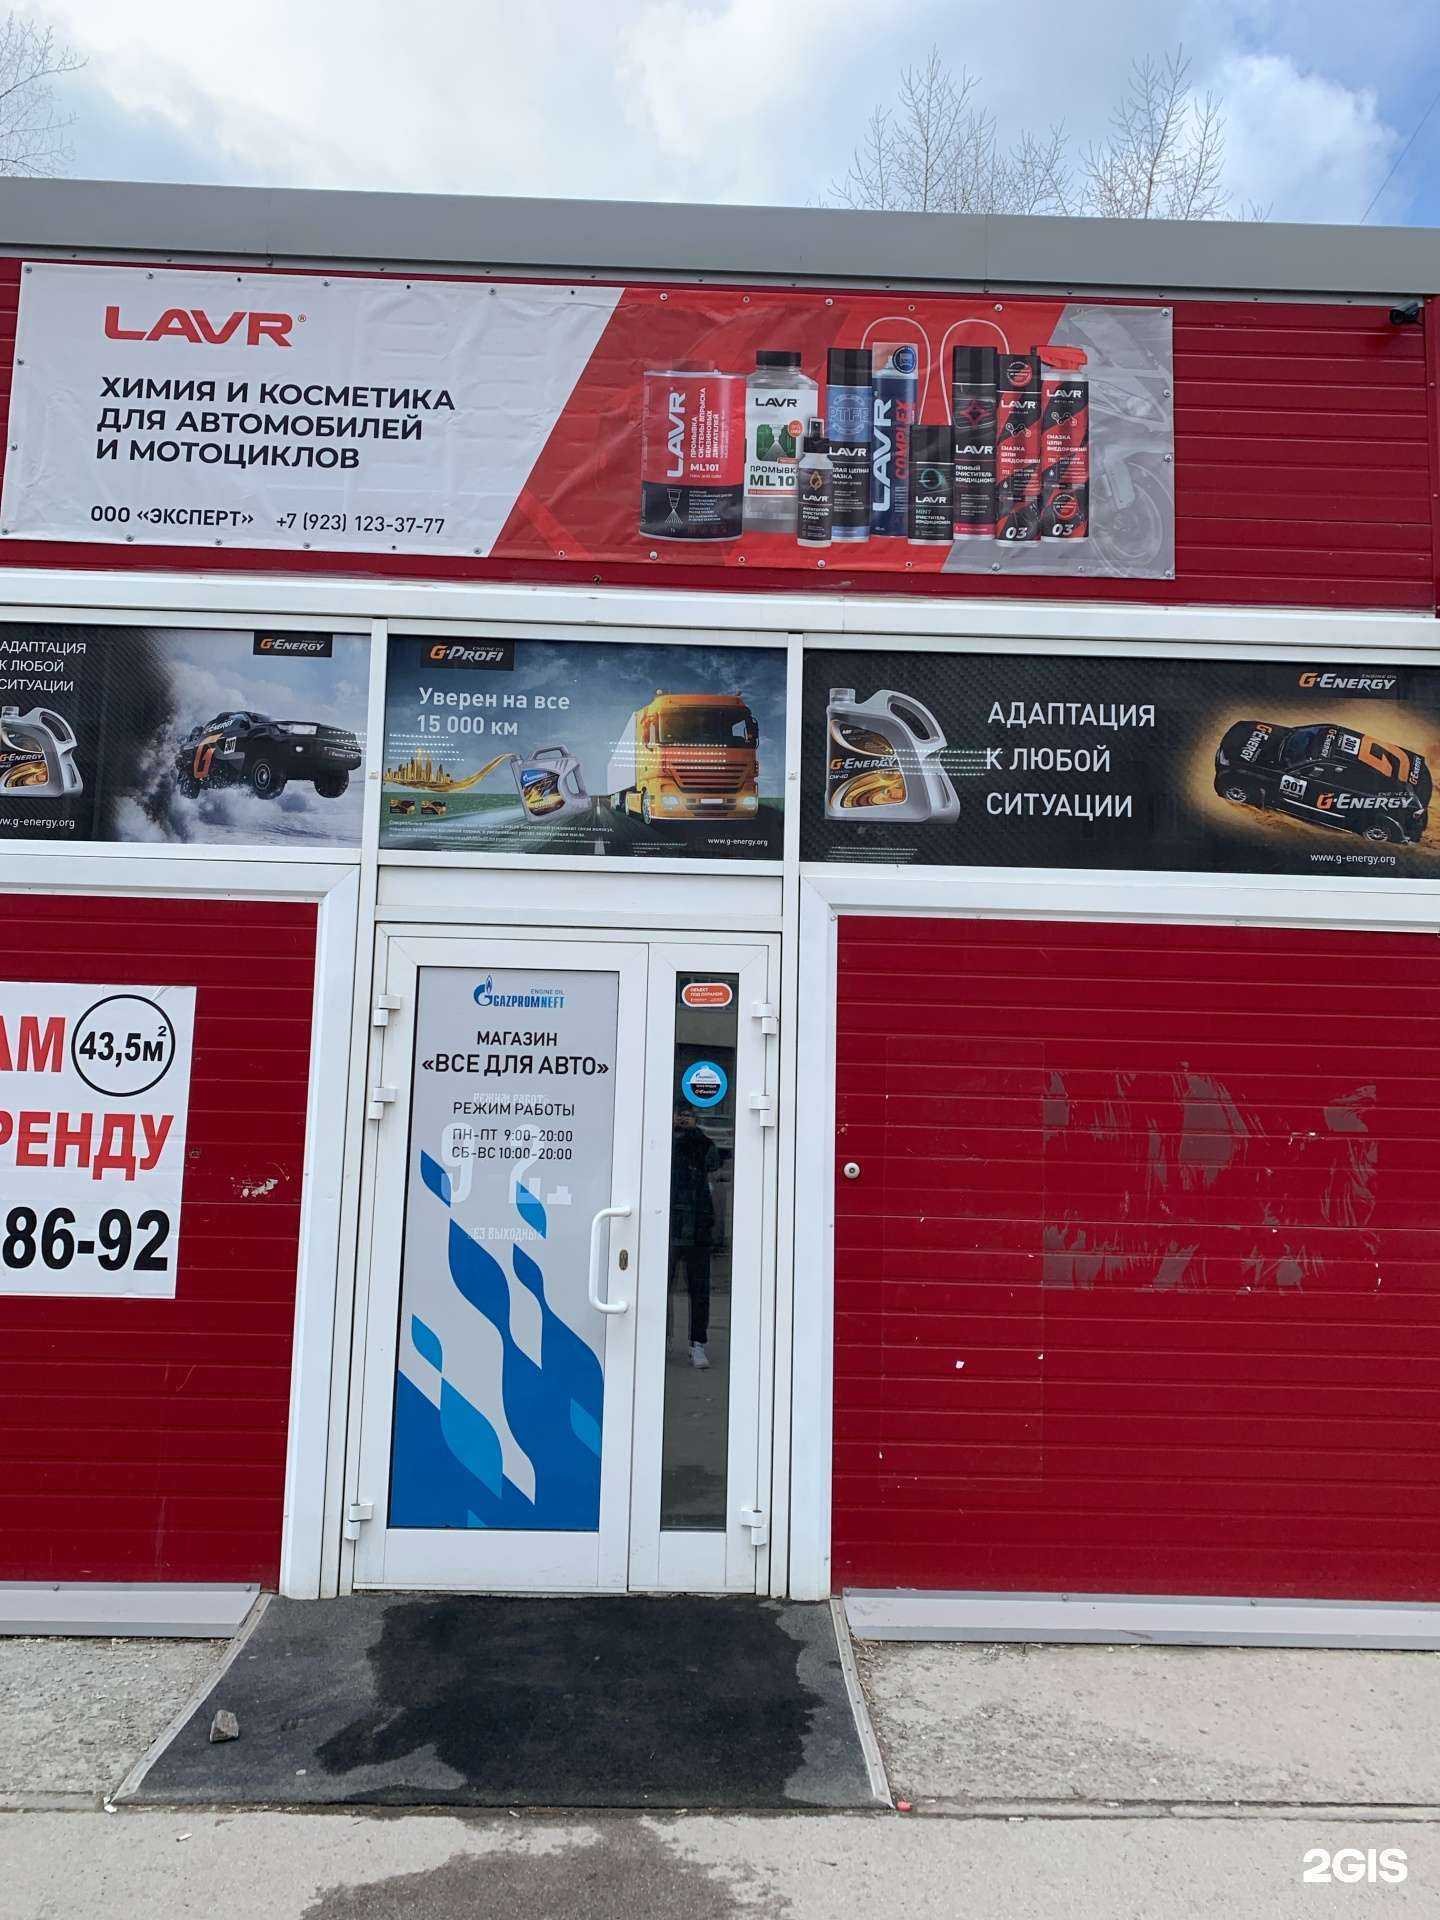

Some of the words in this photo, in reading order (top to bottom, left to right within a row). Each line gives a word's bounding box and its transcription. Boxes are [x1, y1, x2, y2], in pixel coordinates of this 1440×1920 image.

[101, 377, 215, 401] ХИМИЯ
[227, 382, 249, 403] И
[260, 383, 456, 411] КОСМЕТИКА
[1047, 389, 1083, 398] LAVR
[756, 397, 798, 408] LAVR
[1001, 400, 1036, 409] LAVR
[97, 408, 166, 432] ДЛЯ
[176, 411, 423, 440] АВТОМОБИЛЕЙ
[667, 393, 686, 477] LAVR
[97, 439, 118, 460] И
[129, 440, 360, 469] МОТОЦИКЛОВ
[829, 447, 867, 457] LAVR
[873, 399, 892, 511] LAVR
[955, 444, 993, 454] LAVR
[690, 463, 719, 472] ML101
[803, 494, 829, 502] LAVR
[91, 506, 130, 522] ООО
[137, 508, 254, 526] «ЭКСПЕРТ»
[277, 513, 297, 528] +7
[303, 512, 347, 532] (923)
[355, 515, 445, 533] 123-37-77
[1006, 527, 1028, 539] 03
[1052, 524, 1074, 536] 03
[0, 640, 87, 656] АДАПТАЦИЯ
[10, 659, 64, 672] ЛЮБОЙ
[0, 679, 74, 694] СИТУАЦИИ
[418, 687, 497, 710] Уверен
[503, 694, 527, 708] на
[534, 695, 570, 709] все
[988, 701, 1156, 730] АДАПТАЦИЯ
[417, 715, 441, 732] 15
[447, 716, 484, 734] 000
[491, 722, 518, 735] км
[986, 747, 1003, 770] К
[1009, 745, 1110, 772] ЛЮБОЙ
[1282, 779, 1303, 793] 301
[986, 793, 1133, 821] СИТУАЦИИ
[708, 837, 768, 847] www.g-energy.org
[1310, 852, 1396, 865] www.g-energy.org
[493, 994, 565, 1008] GAZPROMNEFT
[477, 1031, 558, 1047] МАГАЗИН
[422, 1053, 480, 1073] «ВСЕ
[484, 1054, 533, 1077] ДЛЯ
[538, 1056, 609, 1075] АВТО»
[453, 1101, 511, 1115] РЕЖИМ
[514, 1103, 575, 1116] РАБОТЫ
[452, 1128, 498, 1140] ПН-ПТ
[504, 1129, 573, 1142] 9:00-20:00
[452, 1146, 496, 1158] СБ-ВС
[499, 1147, 572, 1160] 10:00-20:00
[2, 1206, 170, 1271] 86-92
